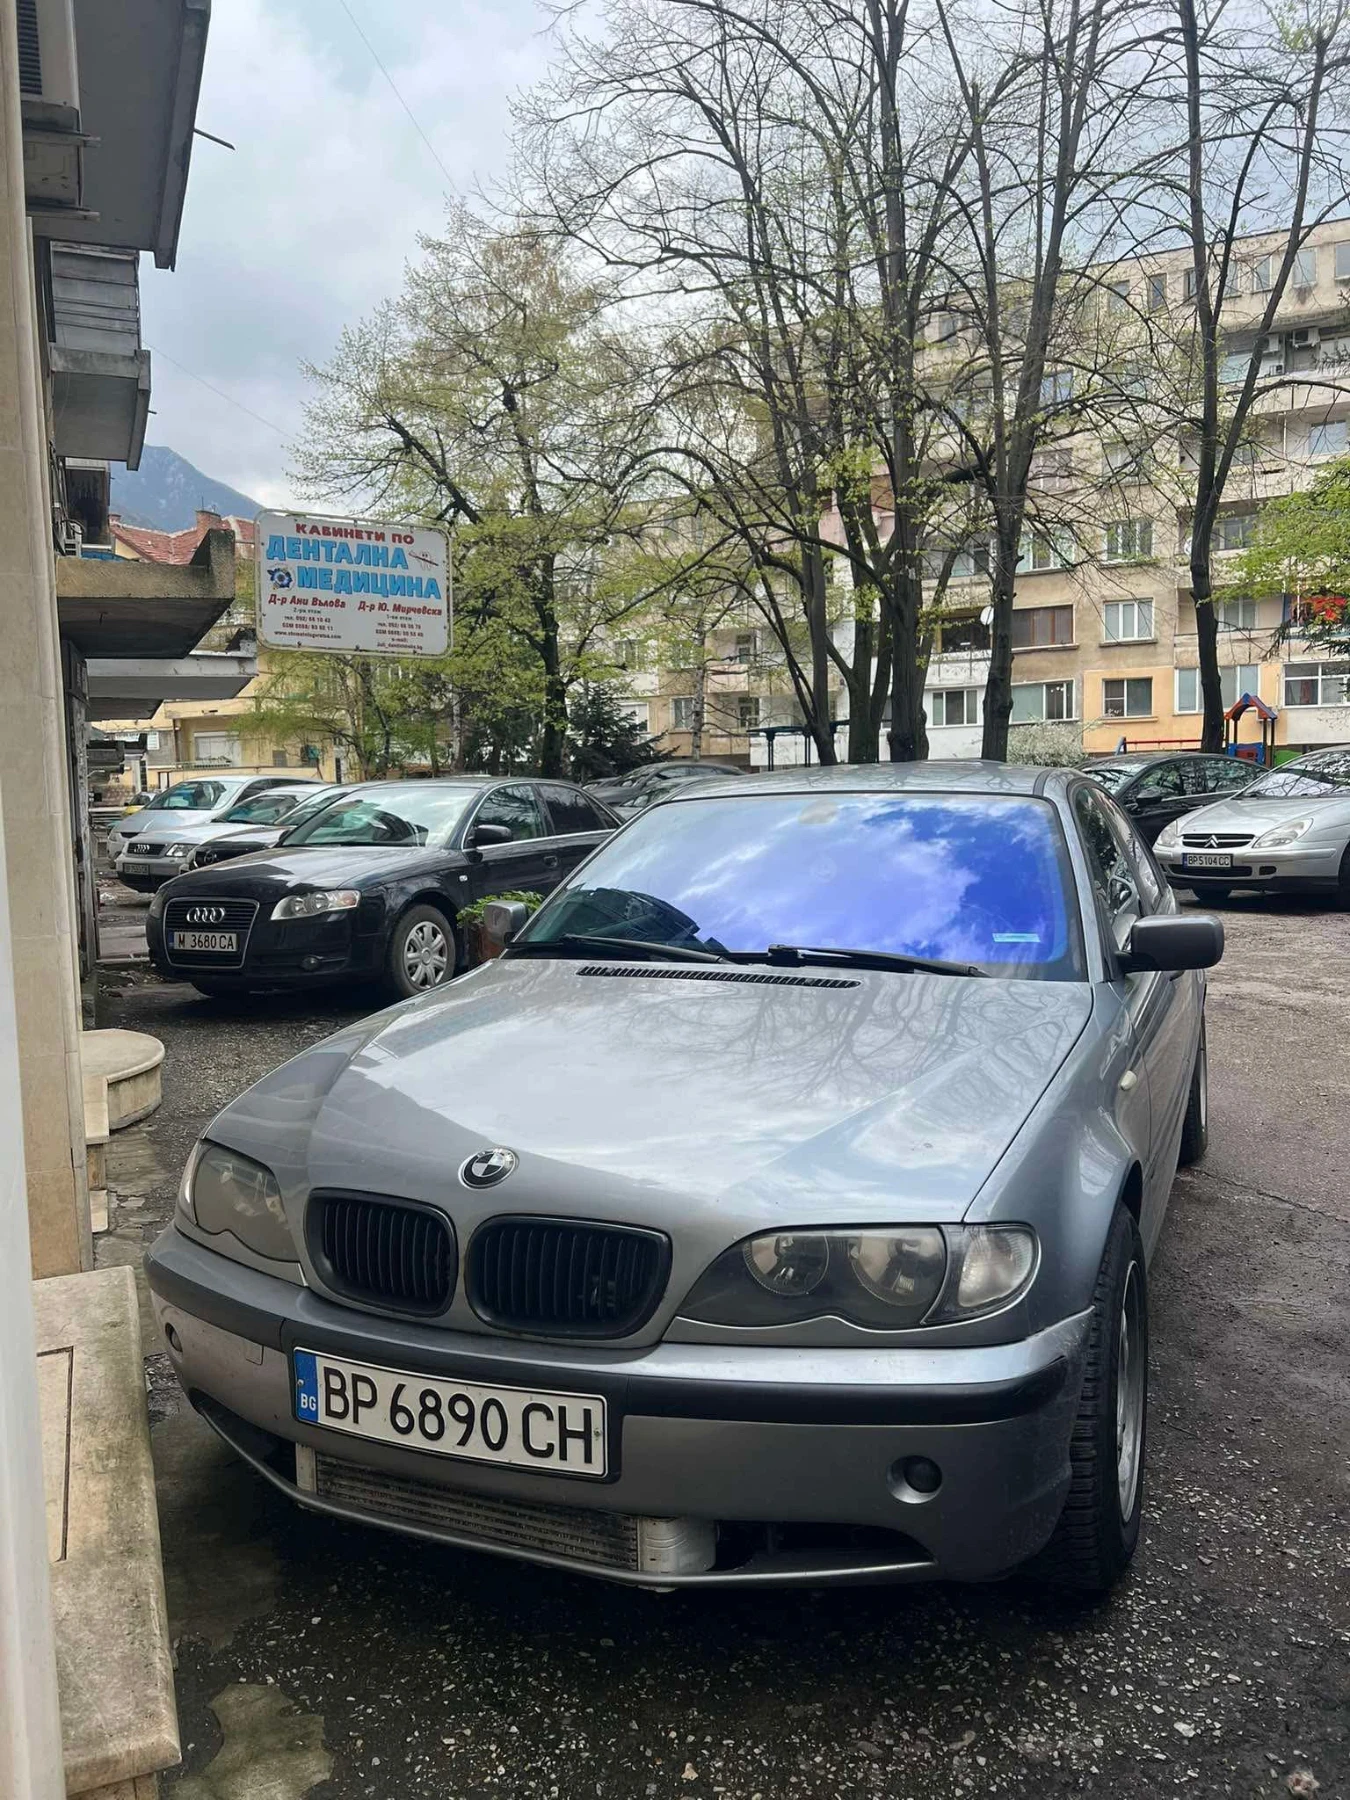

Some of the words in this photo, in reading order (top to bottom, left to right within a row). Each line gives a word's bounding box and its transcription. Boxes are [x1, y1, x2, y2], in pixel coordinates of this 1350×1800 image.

[295, 523, 386, 542] КАБИНЕТИ
[391, 533, 415, 545] ПО
[266, 534, 409, 569] ДЕНТАЛНА
[297, 565, 442, 600] МЕДИЦИНА
[268, 593, 287, 605] Д-р
[290, 595, 309, 606] Ани
[311, 597, 346, 608] Вълова
[357, 601, 375, 612] Д-р
[190, 934, 217, 949] 3680
[218, 935, 234, 950] CA
[300, 1393, 316, 1411] BG
[323, 1366, 378, 1424] BP
[389, 1383, 509, 1452] 6890
[521, 1401, 593, 1464] CH
